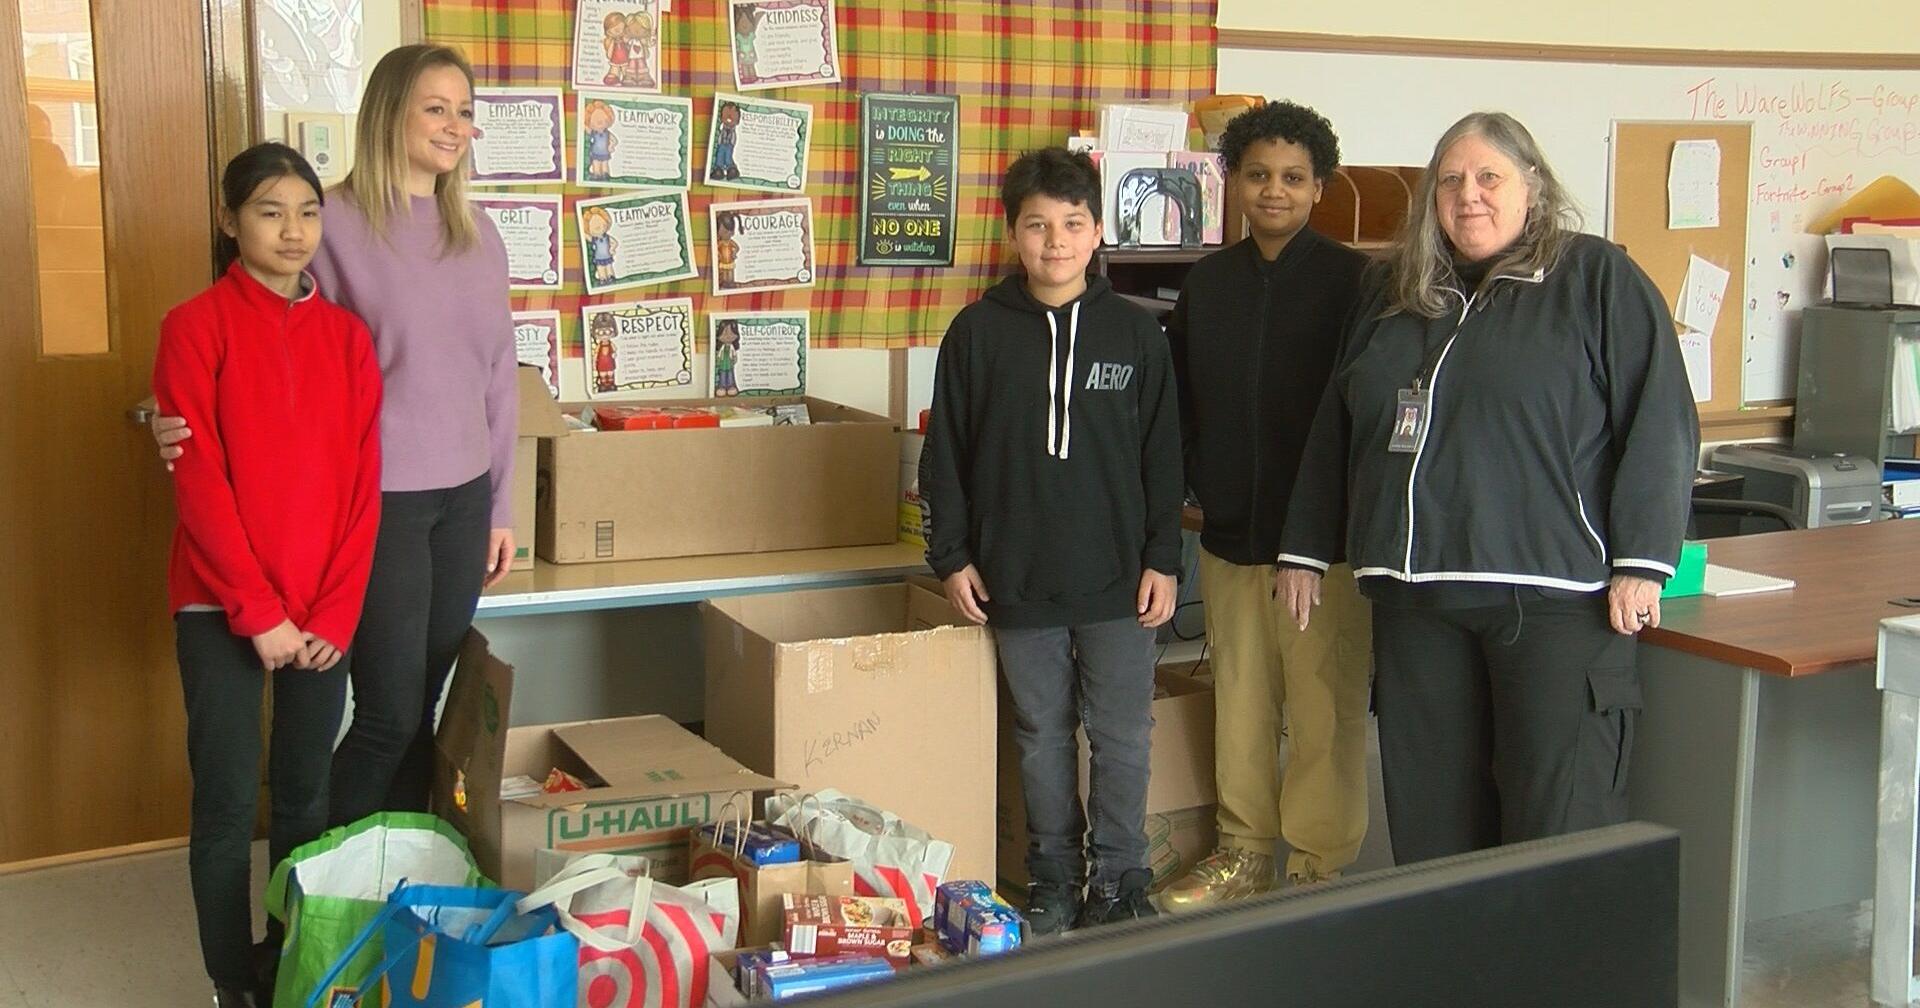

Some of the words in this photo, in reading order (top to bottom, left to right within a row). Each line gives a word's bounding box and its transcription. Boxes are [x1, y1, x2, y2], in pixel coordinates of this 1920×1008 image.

[766, 9, 819, 25] KINDNESS
[1687, 77, 1727, 120] The
[488, 104, 543, 118] EMPATHY
[617, 110, 678, 125] TEAMWORK
[871, 107, 950, 124] INTEGRITY
[742, 112, 799, 127] RESPONSIBILITY
[875, 124, 885, 141] is
[888, 125, 925, 142] DOING
[926, 127, 946, 143] the
[888, 148, 933, 164] RIGHT
[888, 182, 932, 197] THING
[613, 204, 672, 223] TEAMWORK
[887, 201, 907, 211] even
[907, 199, 931, 212] when
[500, 209, 531, 224] GRIT
[744, 214, 801, 231] COURAGE
[872, 217, 900, 236] NO
[904, 219, 941, 237] ONE
[903, 241, 935, 256] watching
[621, 315, 679, 335] RESPECT
[741, 326, 798, 336] SELF-CONTROL
[1085, 362, 1134, 391] AERO
[560, 802, 699, 839] U-HAUL
[838, 937, 863, 945] BROWN
[864, 938, 885, 946] SUGAR
[847, 932, 871, 940] MAPLE
